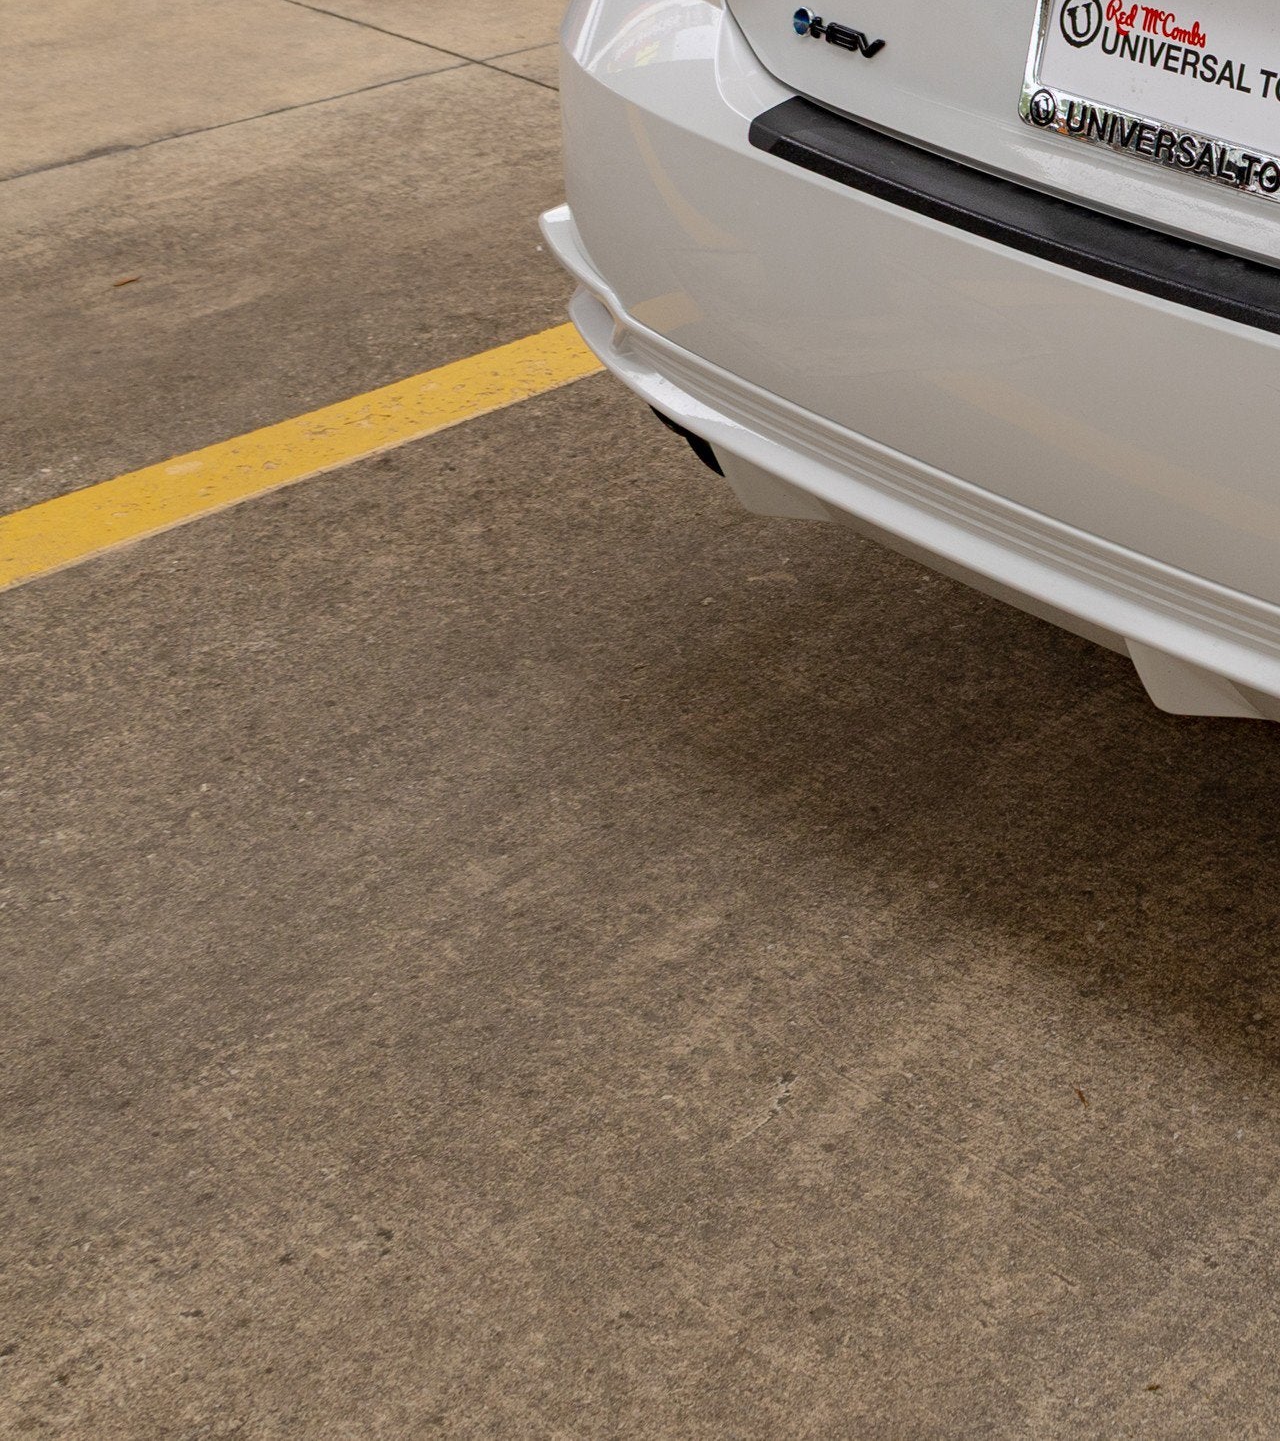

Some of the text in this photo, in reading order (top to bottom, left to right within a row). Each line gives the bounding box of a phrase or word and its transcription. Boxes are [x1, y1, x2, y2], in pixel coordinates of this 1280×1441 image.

[1102, 25, 1251, 94] UNIVERSAL
[1142, 4, 1207, 49] McCombs
[1067, 100, 1237, 180] UNIVERSAL
